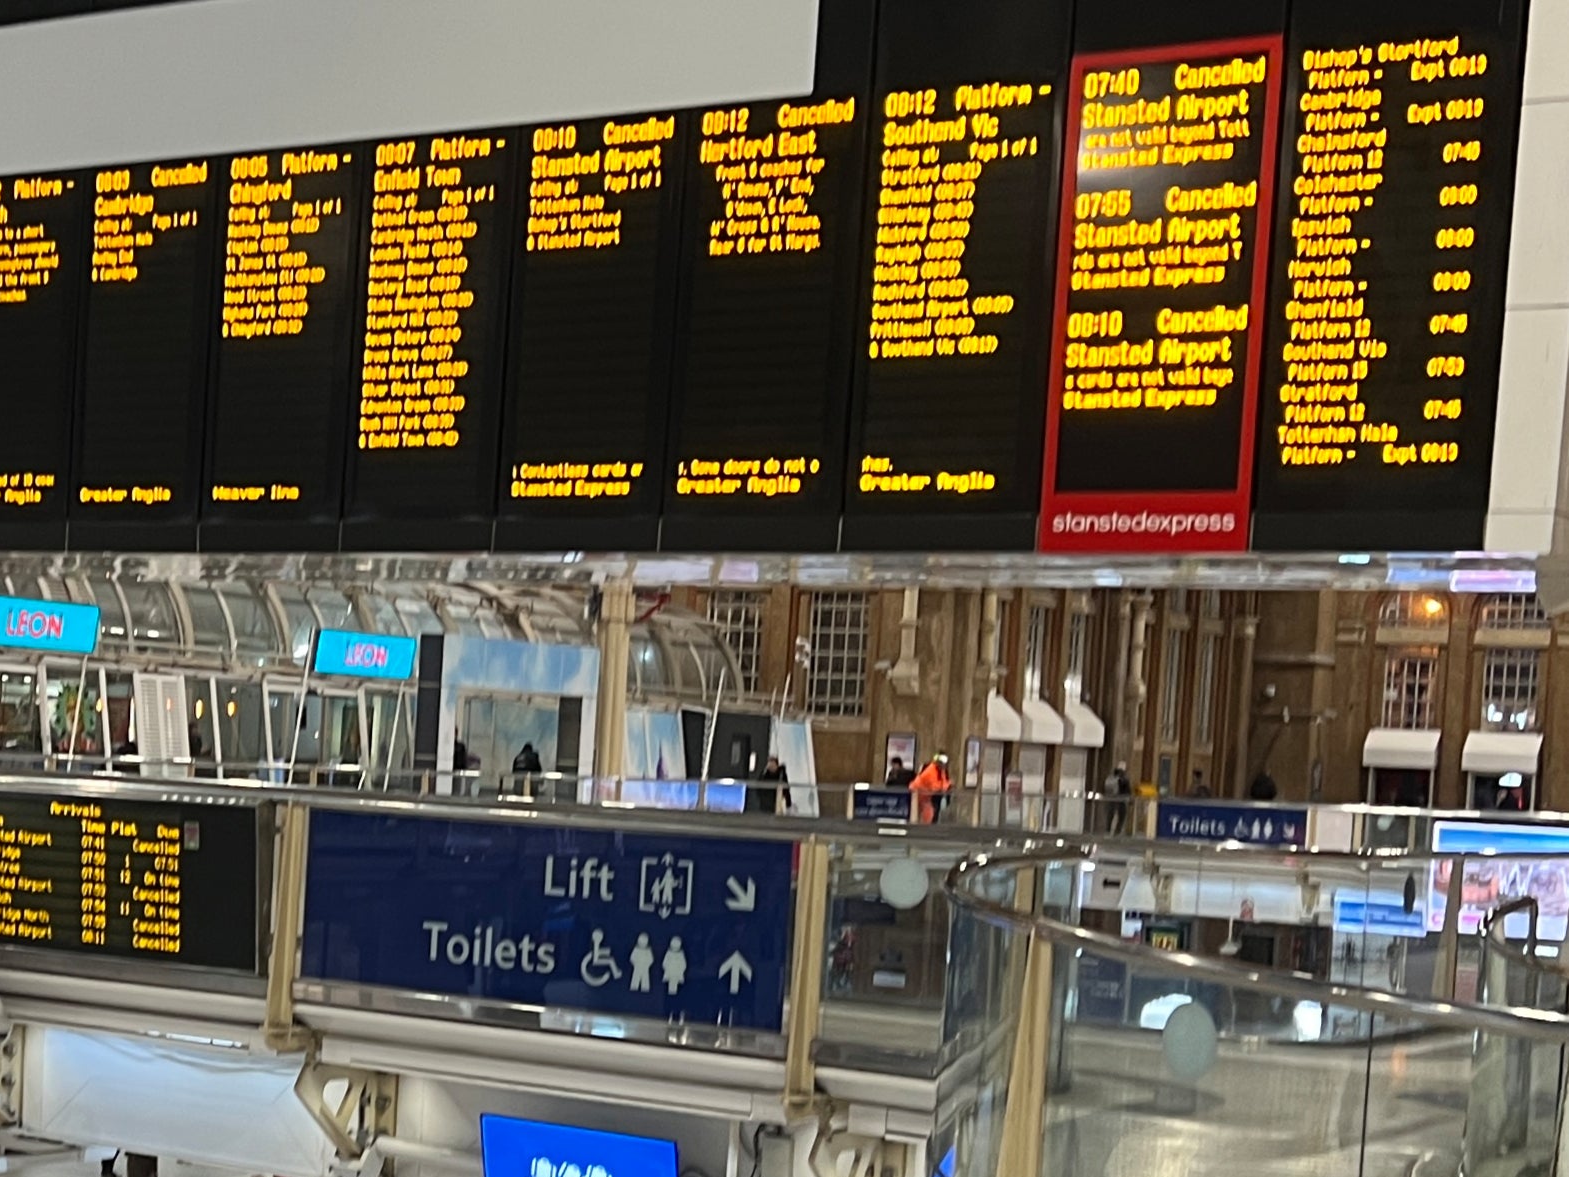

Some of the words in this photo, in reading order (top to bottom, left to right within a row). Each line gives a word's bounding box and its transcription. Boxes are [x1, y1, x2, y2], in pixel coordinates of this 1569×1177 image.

[1377, 35, 1458, 63] Stortford
[1083, 68, 1139, 99] 07:40
[1174, 55, 1266, 90] Cancelled
[1308, 68, 1369, 90] Platform
[955, 81, 1032, 111] Platform
[1083, 95, 1170, 129] Stansted
[1175, 88, 1249, 121] Airport
[1299, 86, 1381, 112] Cambridge
[777, 96, 855, 128] Cancelled
[1305, 110, 1366, 132] Platform
[603, 114, 674, 145] Cancelled
[883, 114, 966, 146] Southend
[971, 112, 998, 138] Vic
[1085, 133, 1107, 150] are
[1109, 128, 1132, 147] not
[1135, 125, 1167, 146] valid
[1169, 120, 1215, 144] beyond
[1297, 127, 1386, 153] Chelmsford
[430, 136, 490, 161] Platform
[699, 132, 773, 164] Hertford
[777, 129, 816, 156] East
[1081, 145, 1159, 171] Stansted
[1161, 142, 1234, 166] Express
[151, 160, 207, 187] Cancelled
[281, 150, 337, 175] Platform
[531, 150, 600, 179] Stansted
[603, 144, 661, 173] Airport
[1302, 152, 1363, 174] Platform
[374, 166, 420, 192] Enfield
[425, 164, 461, 187] Town
[1293, 172, 1383, 195] Colchester
[94, 192, 153, 216] Cambridge
[229, 178, 292, 205] Chingford
[1075, 188, 1131, 219] 07:55
[1165, 179, 1257, 213] Cancelled
[1299, 194, 1360, 215] Platform
[1074, 216, 1162, 249] Stansted
[1167, 212, 1241, 245] Airport
[1097, 250, 1120, 268] are
[1123, 248, 1145, 267] not
[1148, 245, 1181, 265] valid
[1183, 242, 1229, 265] beyond
[1297, 236, 1357, 257] Platform
[1071, 267, 1150, 290] Stansted
[1153, 266, 1225, 288] Express
[1287, 256, 1351, 279] Norwich
[1293, 278, 1354, 299] Platform
[1156, 304, 1249, 333] Cancelled
[1285, 297, 1364, 320] Shenfield
[1291, 320, 1351, 341] Platform
[1065, 338, 1154, 368] Stansted
[1157, 336, 1231, 366] Airport
[1283, 339, 1354, 362] Southend
[1115, 371, 1139, 387] are
[1141, 368, 1164, 387] not
[1167, 366, 1200, 385] valid
[1287, 362, 1348, 382] Platform
[1063, 388, 1142, 410] Stansted
[1144, 387, 1217, 411] Express
[1279, 381, 1358, 403] Stratford
[1285, 403, 1345, 424] Platform
[1277, 424, 1356, 445] Tottenham
[1360, 422, 1398, 443] Hale
[1281, 445, 1343, 465] Platform
[859, 474, 931, 494] Greater
[937, 471, 995, 492] Anglia
[1052, 509, 1236, 537] stanstedexpress
[5, 607, 65, 639] LEON
[343, 640, 389, 670] LEON
[50, 800, 101, 818] Arrivals
[81, 818, 105, 835] Time
[111, 820, 137, 836] Plat
[157, 824, 179, 839] Due
[1169, 815, 1226, 837] Toilets
[18, 830, 51, 846] Airport
[132, 838, 180, 856] Cancelled
[18, 876, 51, 893] Airport
[133, 886, 180, 904] Cancelled
[143, 870, 155, 886] On
[159, 872, 179, 889] time
[544, 855, 615, 902] Lift
[23, 908, 49, 923] North
[133, 917, 180, 936] Cancelled
[143, 902, 155, 917] On
[159, 904, 179, 920] time
[18, 922, 51, 940] Airport
[133, 934, 180, 953] Cancelled
[423, 921, 557, 975] Toilets
